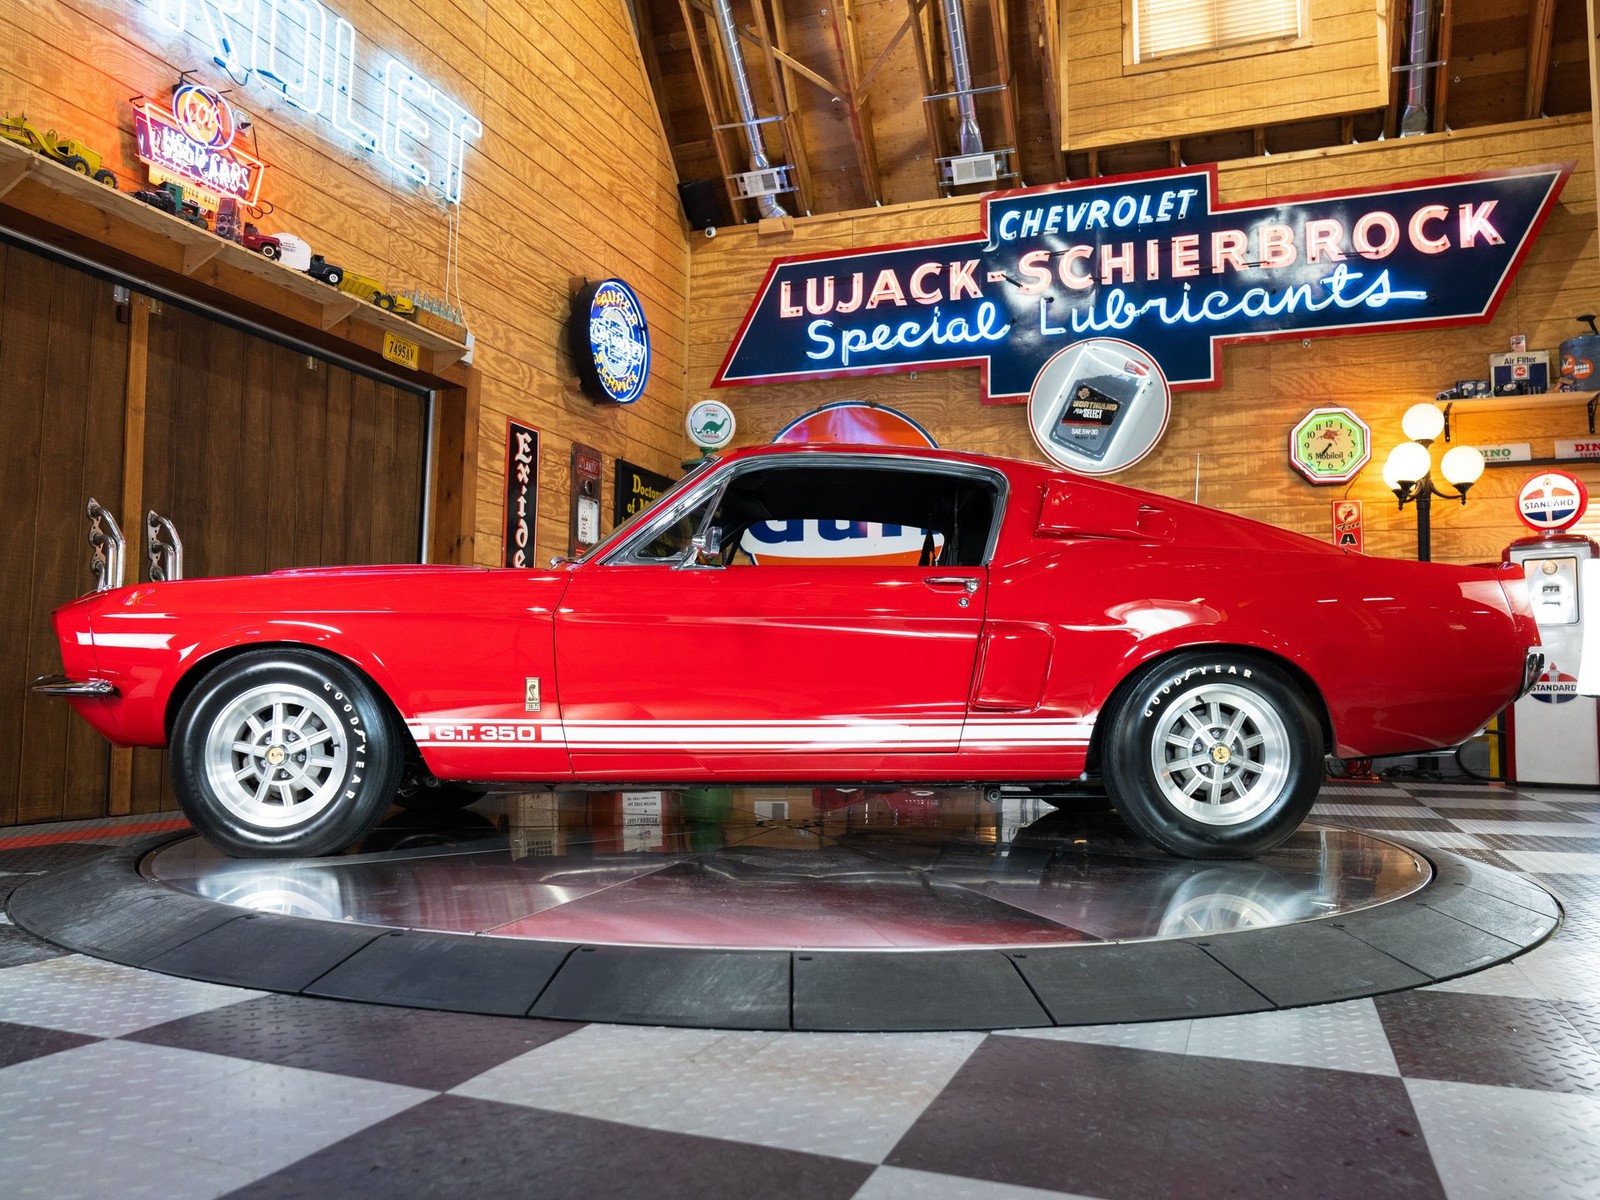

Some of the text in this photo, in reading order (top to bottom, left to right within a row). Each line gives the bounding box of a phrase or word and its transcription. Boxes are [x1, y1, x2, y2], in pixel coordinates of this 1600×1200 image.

[1000, 189, 1198, 241] CHEVROLET
[804, 263, 1428, 366] Special Lubricants
[1504, 356, 1536, 366] Air Filter
[1325, 420, 1334, 428] 12
[1071, 428, 1083, 436] SAE
[1307, 431, 1316, 439] 10
[1315, 452, 1344, 460] Mobiloil
[1524, 498, 1575, 511] STANDARD
[1143, 664, 1253, 719] GOODYEAR
[480, 726, 536, 741] 350
[322, 680, 369, 801] GOODYEAR
